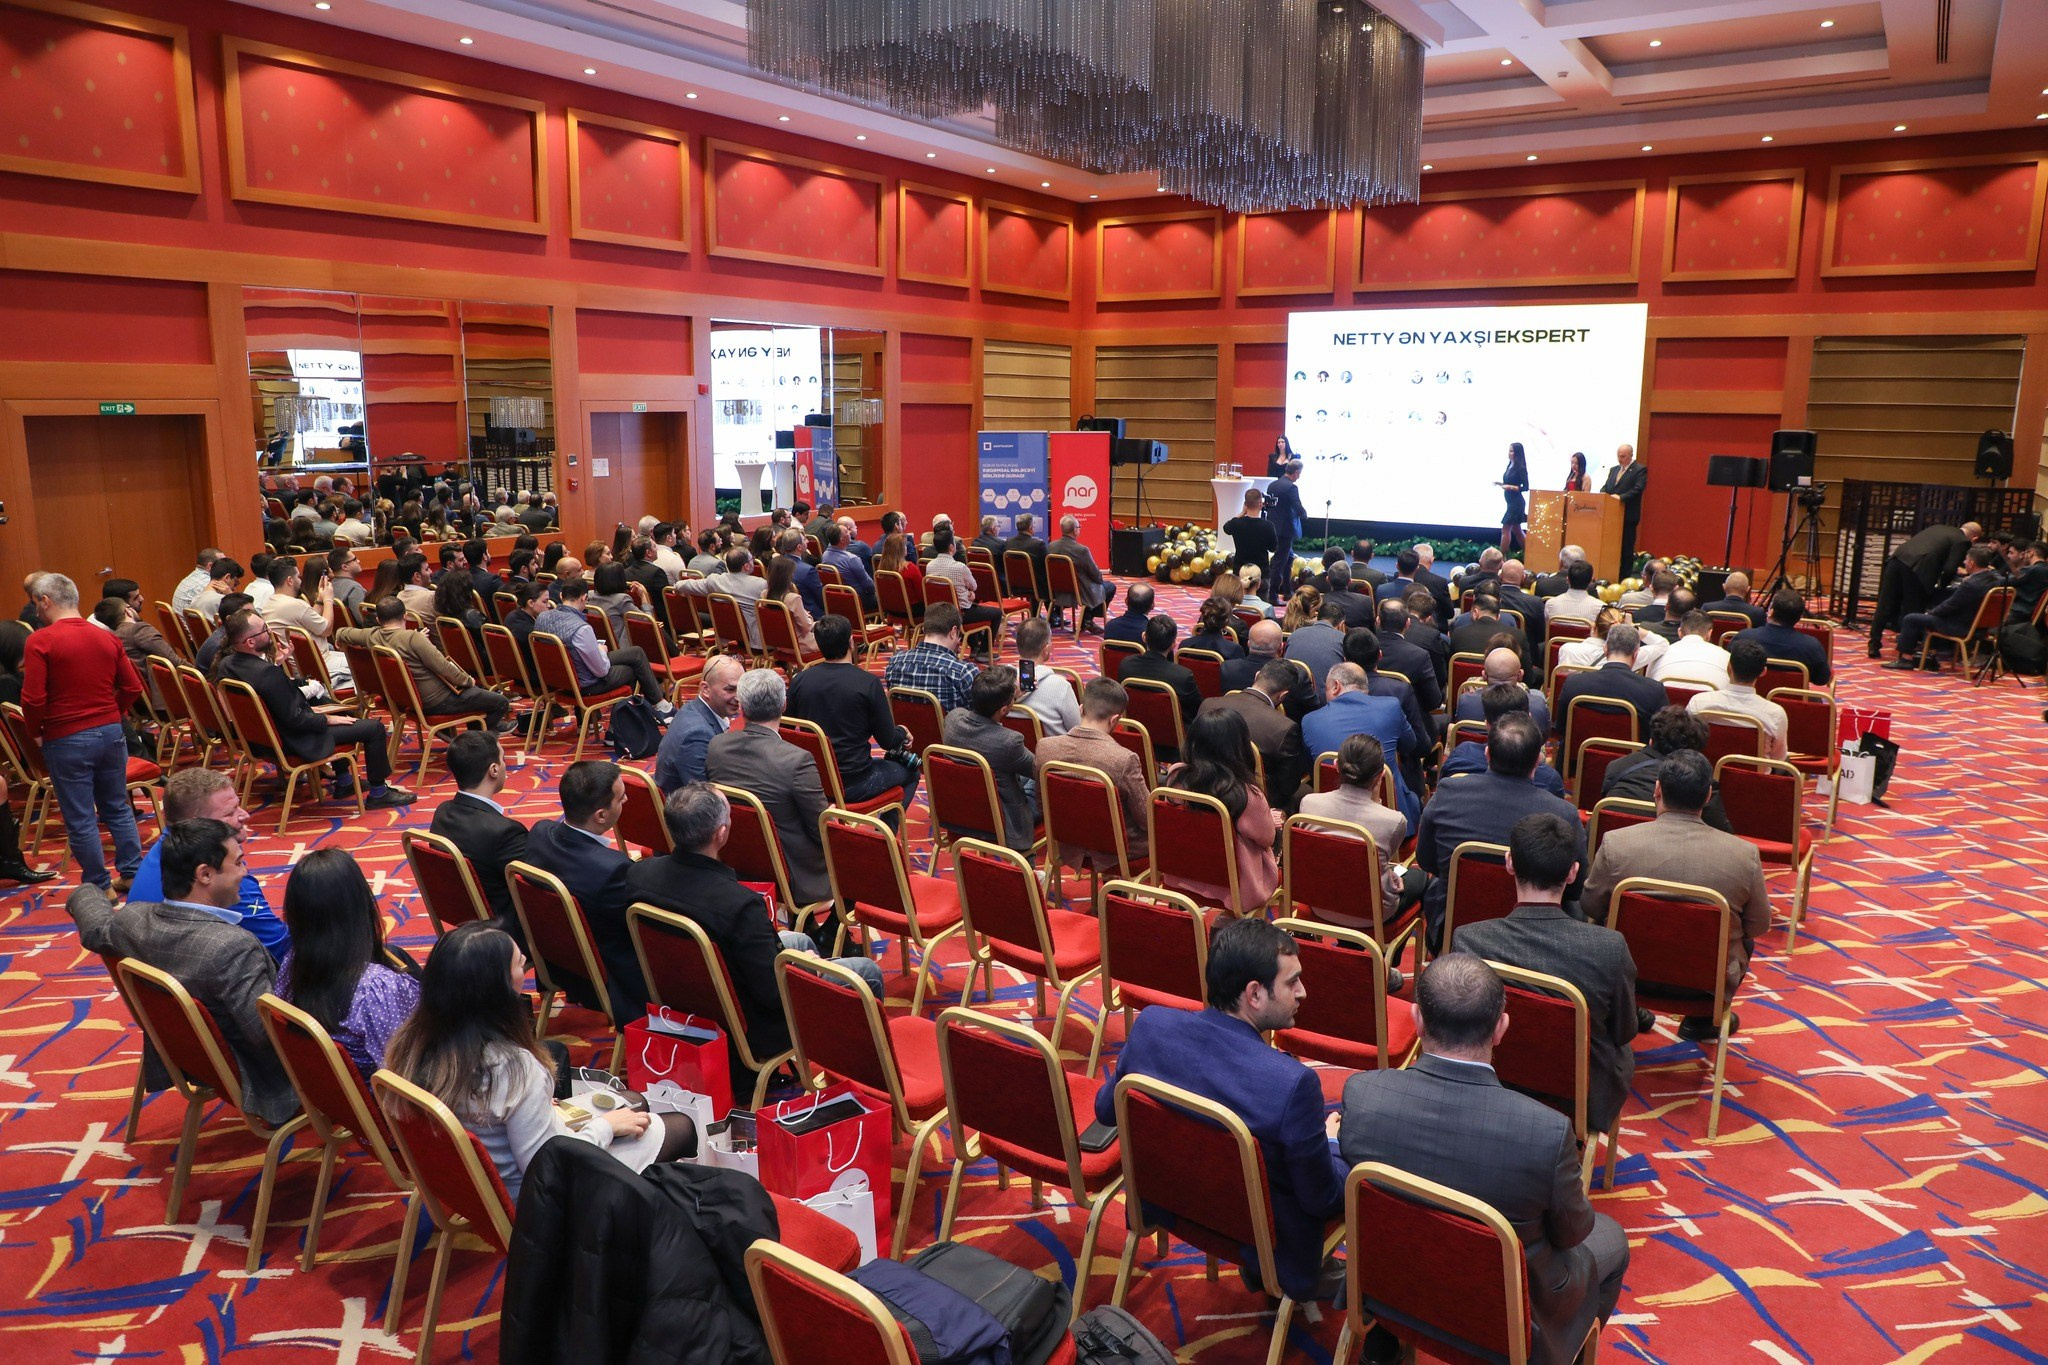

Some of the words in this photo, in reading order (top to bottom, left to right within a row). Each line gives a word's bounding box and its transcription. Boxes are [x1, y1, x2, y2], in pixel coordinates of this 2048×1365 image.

[1333, 332, 1394, 346] NETTY
[1398, 332, 1425, 344] ƏN
[1429, 330, 1491, 348] YAXŞI
[1494, 328, 1591, 344] EKSPERT
[1067, 486, 1096, 497] nar
